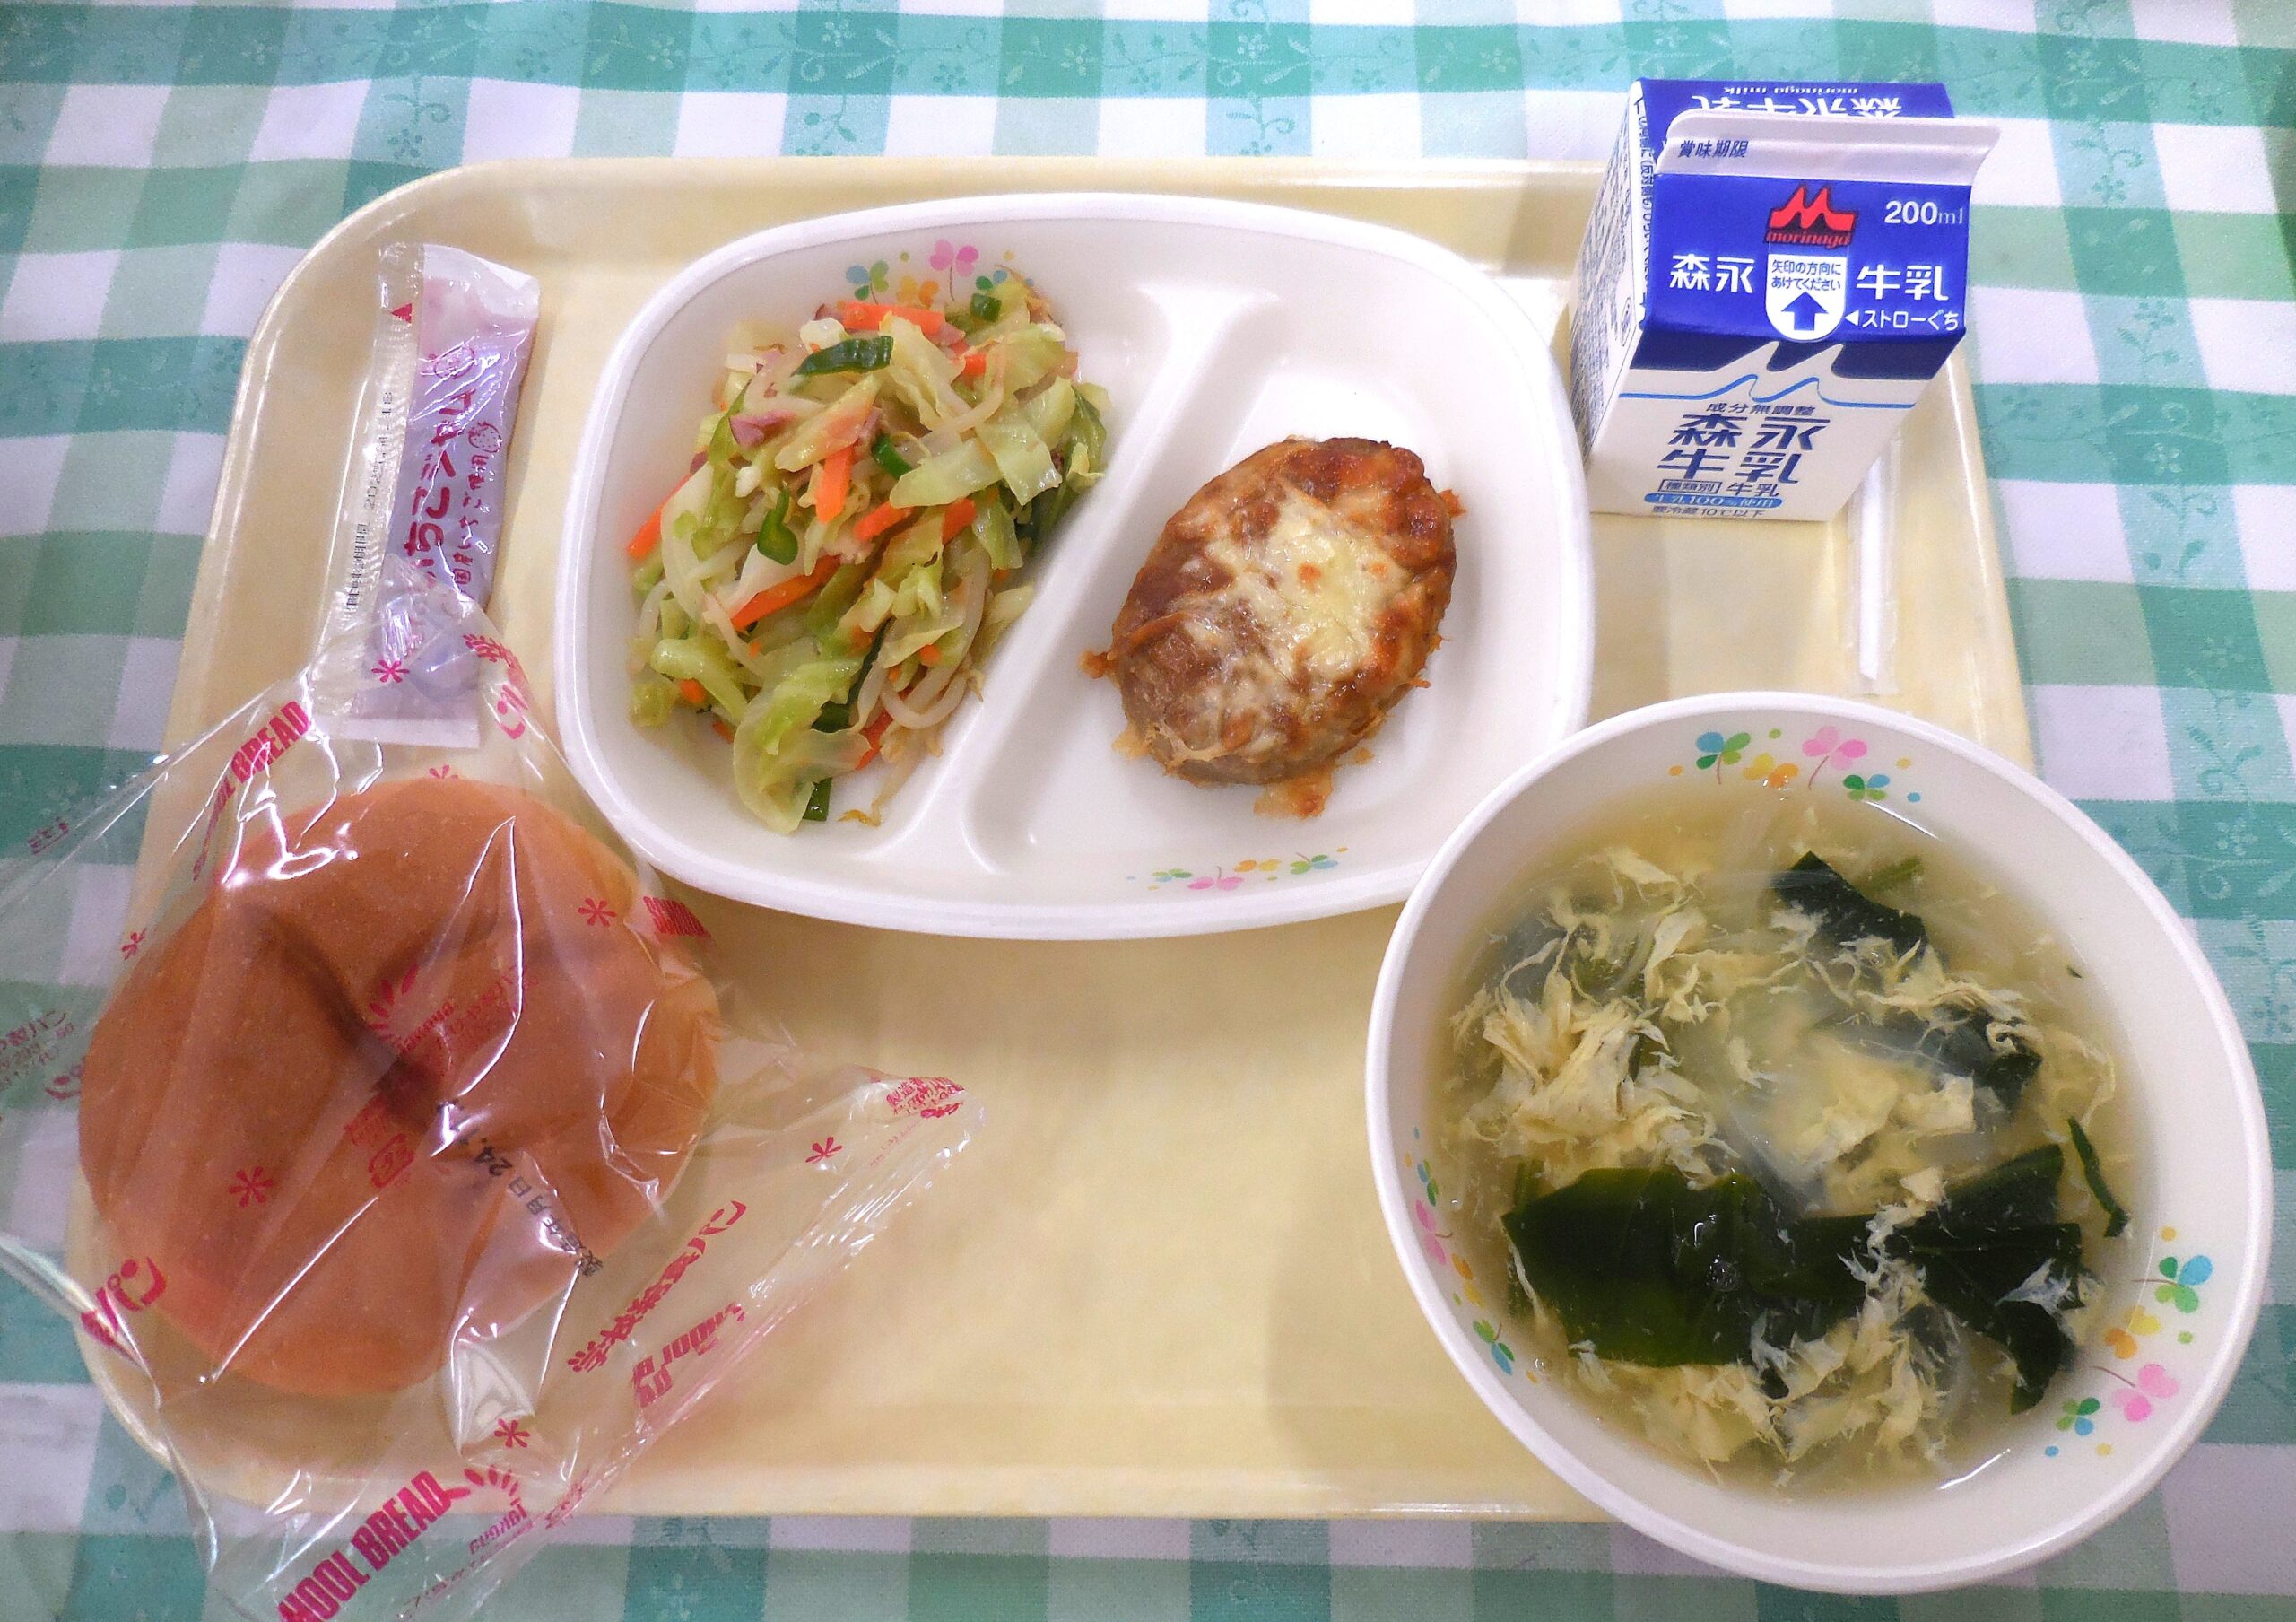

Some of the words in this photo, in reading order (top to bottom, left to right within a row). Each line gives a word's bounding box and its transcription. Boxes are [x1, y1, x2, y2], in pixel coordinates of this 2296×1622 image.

[1677, 140, 1749, 160] 賞味期限
[1883, 200, 1965, 226] 200ml
[1765, 231, 1853, 249] morinaga
[1669, 253, 1755, 294] 森永
[1856, 264, 1949, 301] 牛乳
[1771, 258, 1842, 276] 矢印の方向に
[1770, 275, 1842, 292] あけてください
[1862, 310, 1961, 331] ストローぐち
[1705, 402, 1816, 416] 成分無調整
[1667, 414, 1831, 450] 森永
[1657, 448, 1803, 484] 牛乳
[1665, 481, 1717, 493] 種類別
[1725, 482, 1779, 497] 牛乳
[230, 700, 310, 784] BREAD
[350, 1471, 450, 1571] BREAD
